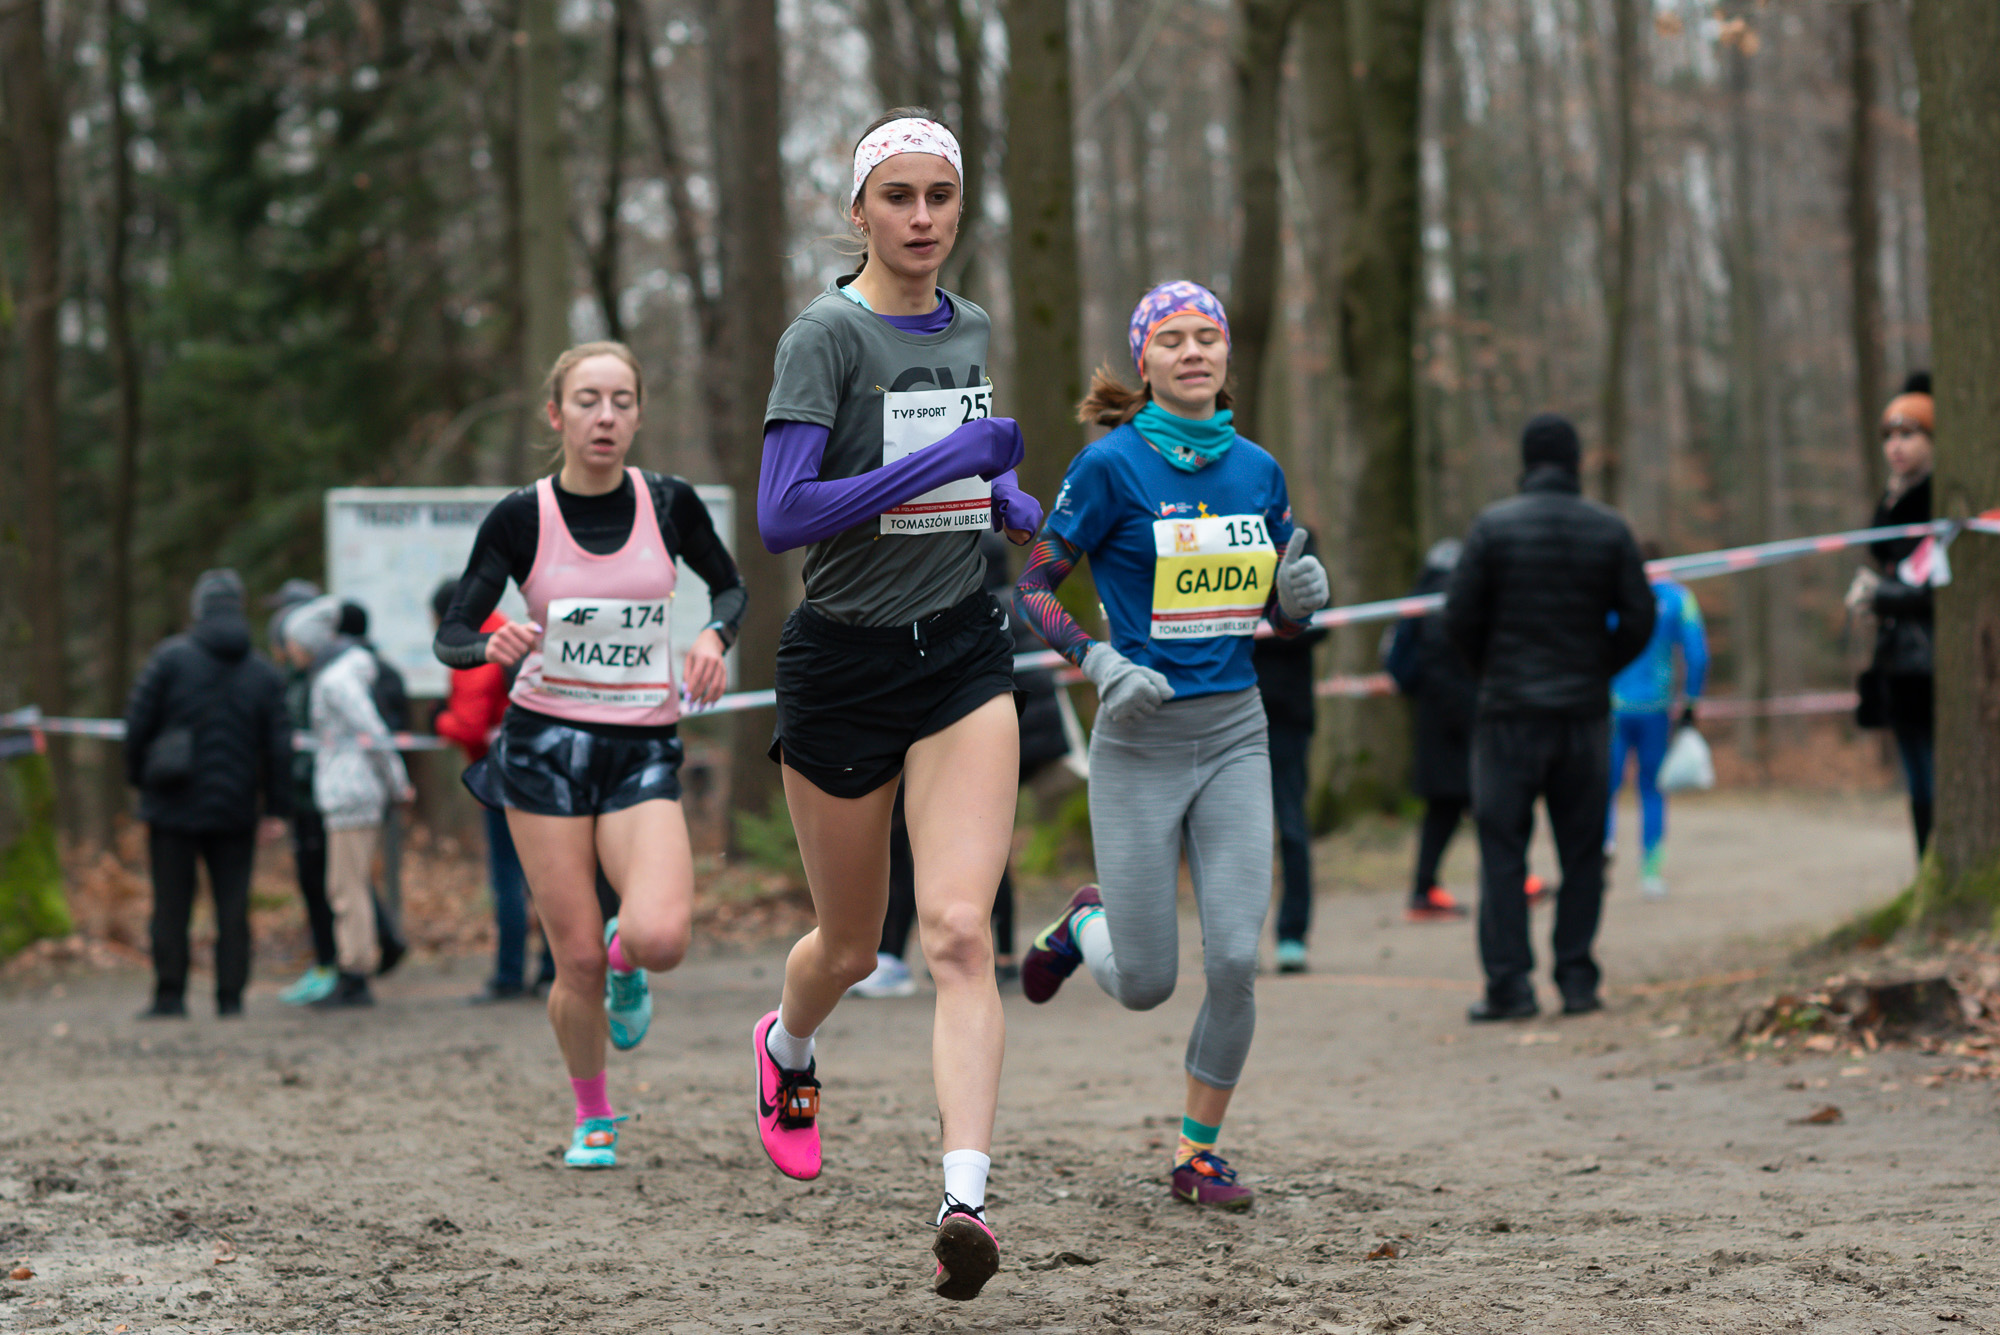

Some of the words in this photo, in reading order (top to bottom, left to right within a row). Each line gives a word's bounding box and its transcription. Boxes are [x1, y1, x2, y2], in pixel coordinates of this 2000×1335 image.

[892, 409, 915, 419] TVP
[917, 407, 947, 418] SPORT
[890, 514, 952, 530] TOMASZÓW
[1225, 521, 1267, 547] 151
[1176, 566, 1258, 594] GAJDA
[562, 607, 599, 626] 4F
[621, 605, 664, 629] 174
[1159, 622, 1213, 634] TOMASZÓW
[1215, 621, 1250, 632] LUBELSKI
[562, 641, 653, 667] MAZEK
